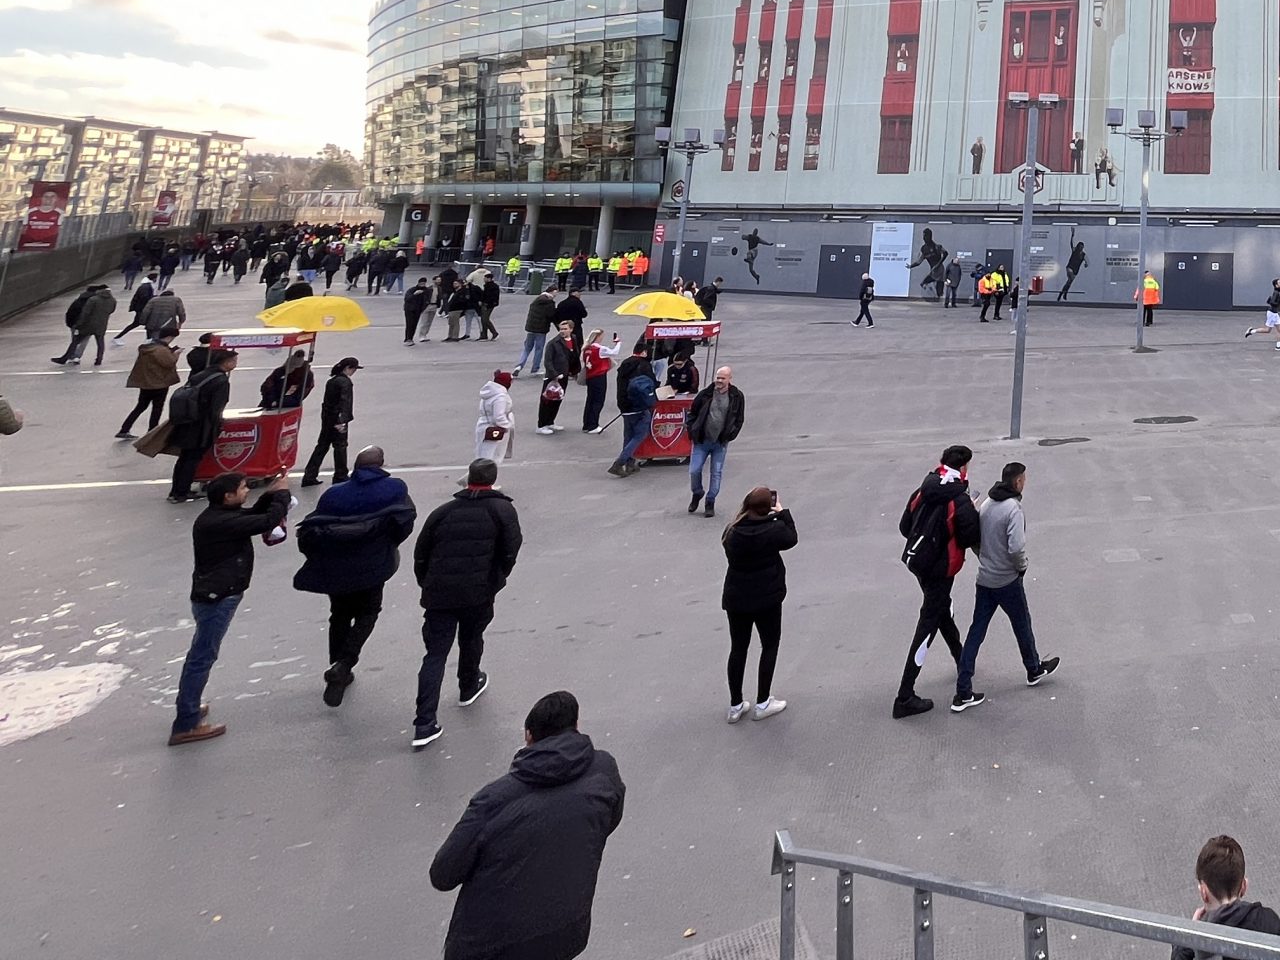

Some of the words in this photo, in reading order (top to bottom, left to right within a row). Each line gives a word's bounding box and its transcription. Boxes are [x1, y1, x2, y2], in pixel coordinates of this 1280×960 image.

[1168, 70, 1212, 81] ARSENE
[1168, 81, 1210, 91] KNOWS
[411, 208, 422, 221] G
[509, 211, 519, 225] F
[655, 411, 684, 420] Arsenal
[218, 427, 256, 439] Arsenal
